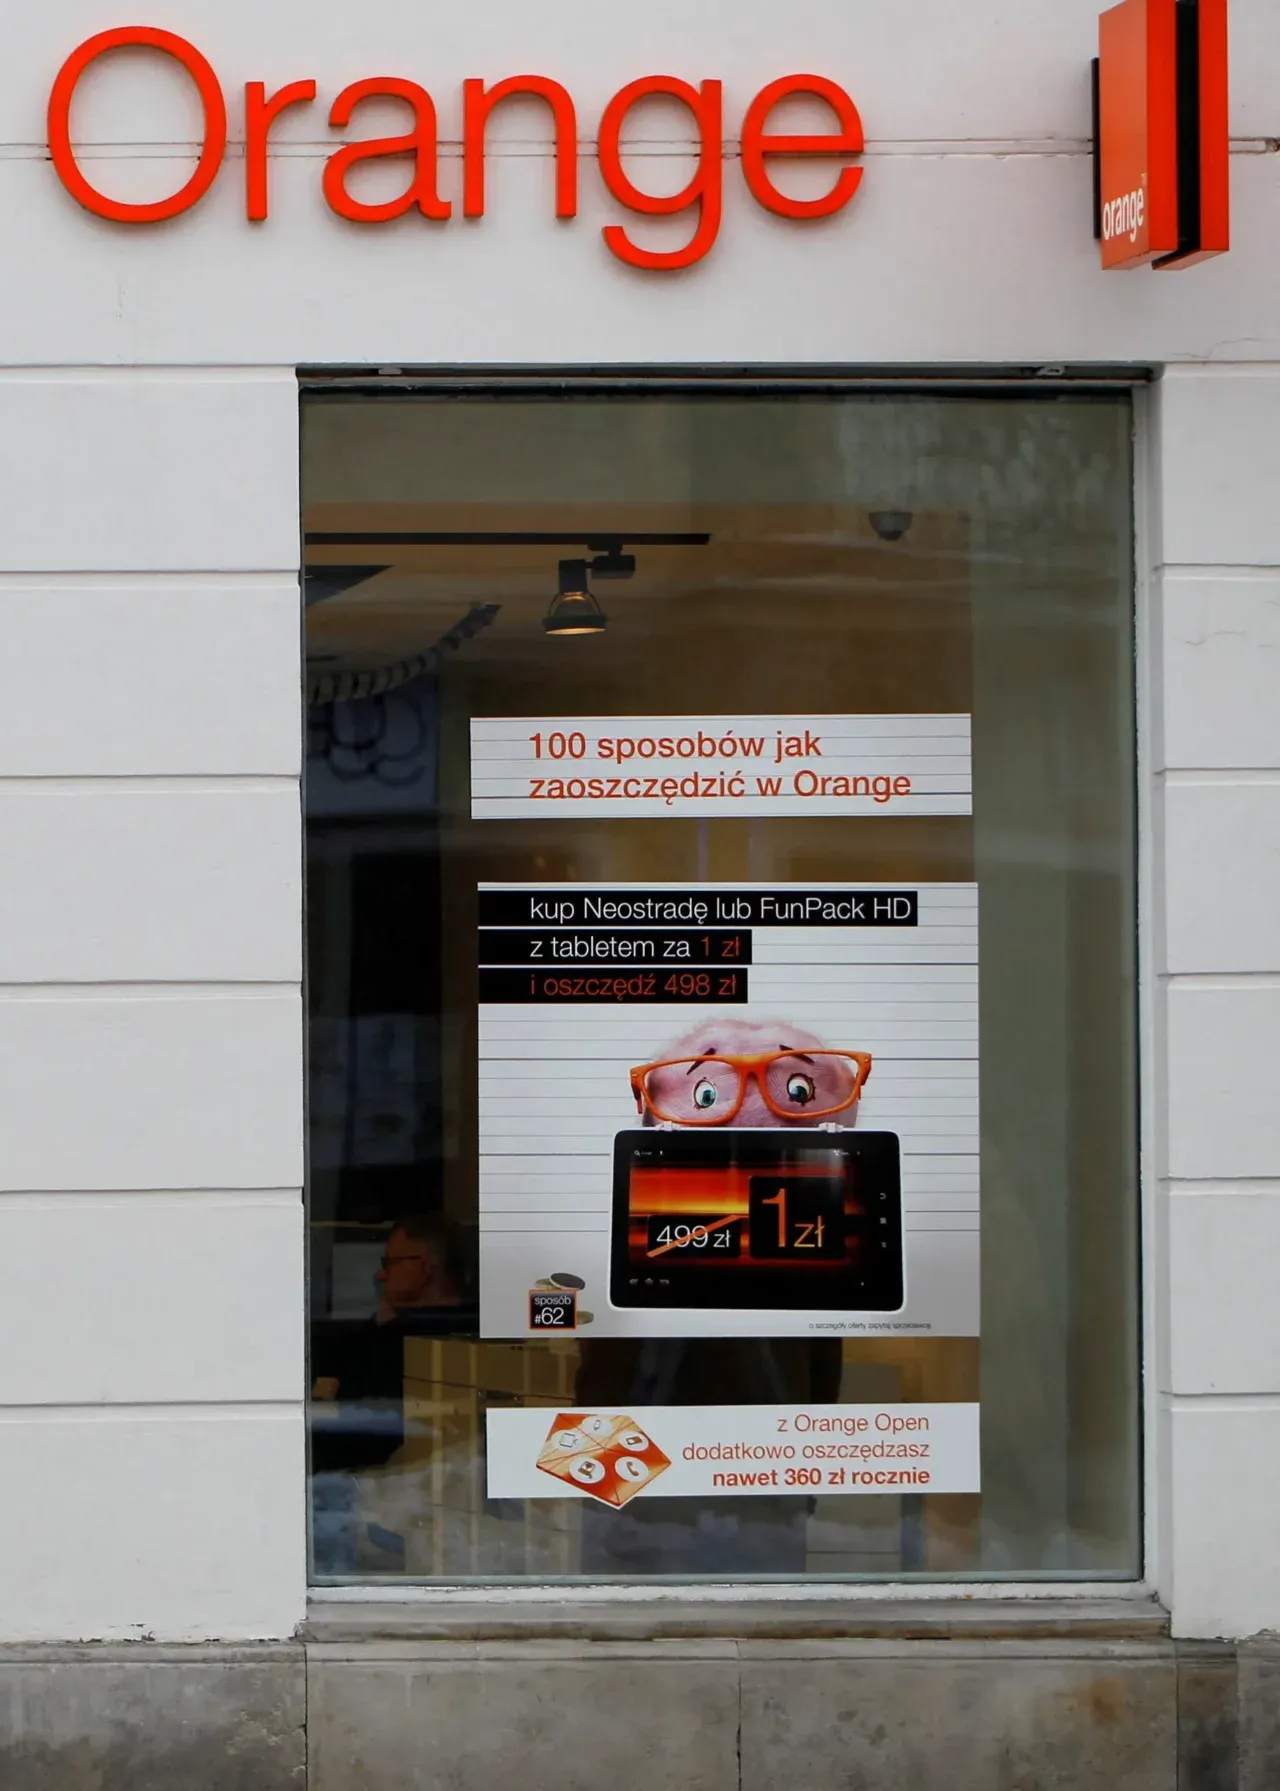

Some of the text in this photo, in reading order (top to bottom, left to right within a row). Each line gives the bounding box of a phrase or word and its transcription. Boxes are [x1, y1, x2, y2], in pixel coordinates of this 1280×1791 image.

[47, 26, 864, 270] Orange
[1102, 187, 1145, 242] orange
[528, 730, 822, 764] 100 sposobów jak
[528, 769, 912, 806] zaoszczędzić w Orange
[530, 896, 912, 926] kup Neostradę lub FunPack HD
[530, 935, 741, 958] z tabletem za 1 zł
[530, 972, 737, 1003] i oszczędź 498 zł
[761, 1187, 826, 1248] 1 zł
[656, 1225, 731, 1248] 499 zł
[534, 1294, 572, 1307] sposób
[534, 1307, 565, 1325] #62
[777, 1413, 930, 1437] z Orange Open
[682, 1441, 931, 1464] dodatkowo oszczędzasz
[712, 1466, 931, 1487] nawet 360 zł rocznie
